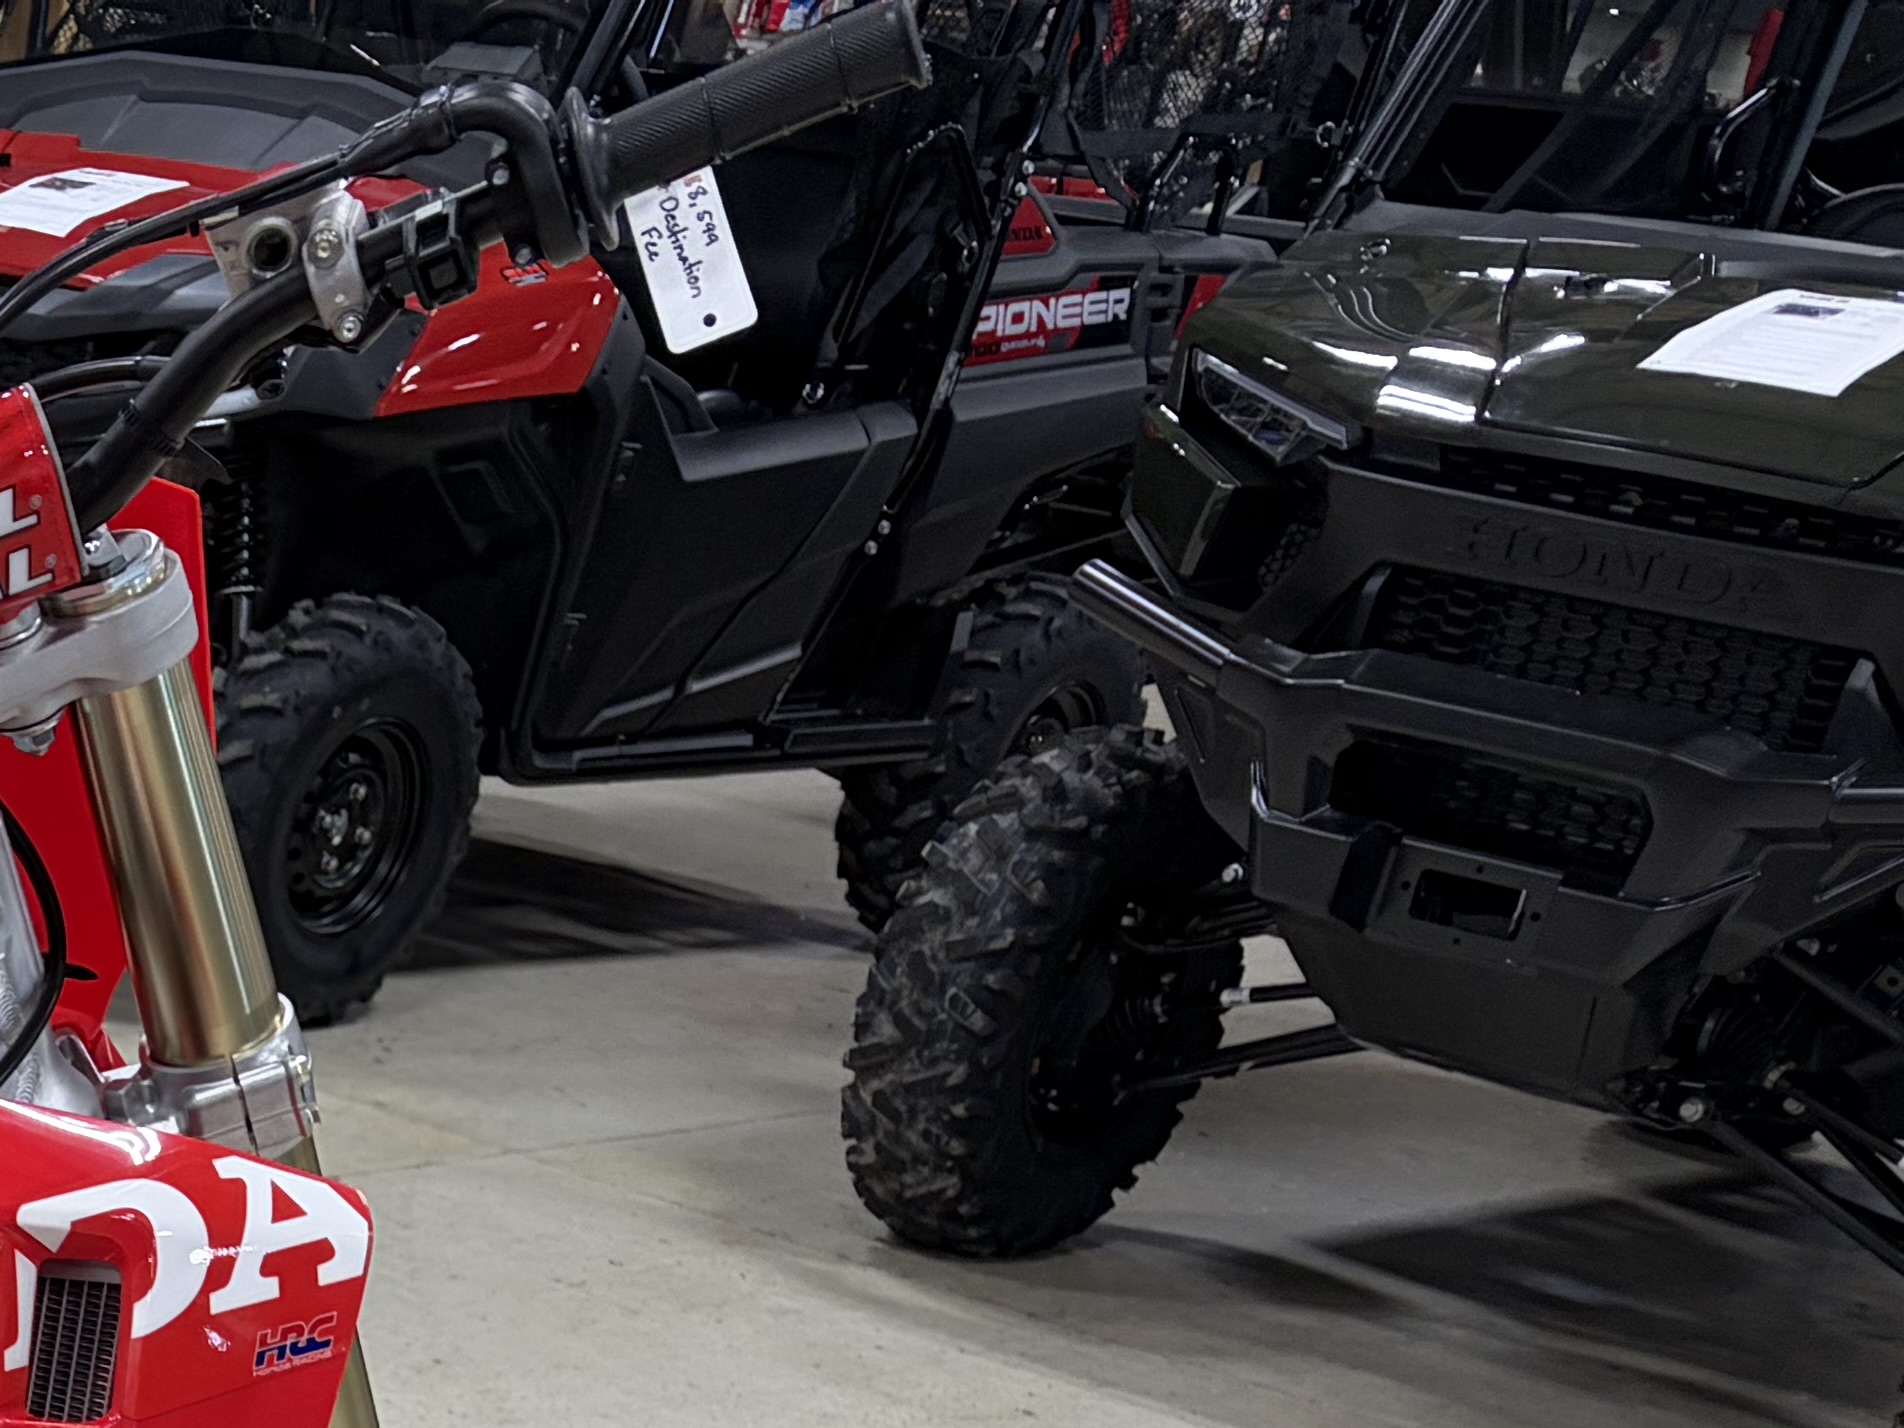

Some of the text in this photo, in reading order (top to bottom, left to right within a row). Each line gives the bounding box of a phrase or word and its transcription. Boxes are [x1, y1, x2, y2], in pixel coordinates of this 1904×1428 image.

[659, 196, 704, 298] Destination
[972, 287, 1131, 340] PIONEER
[253, 1310, 337, 1370] HRC
